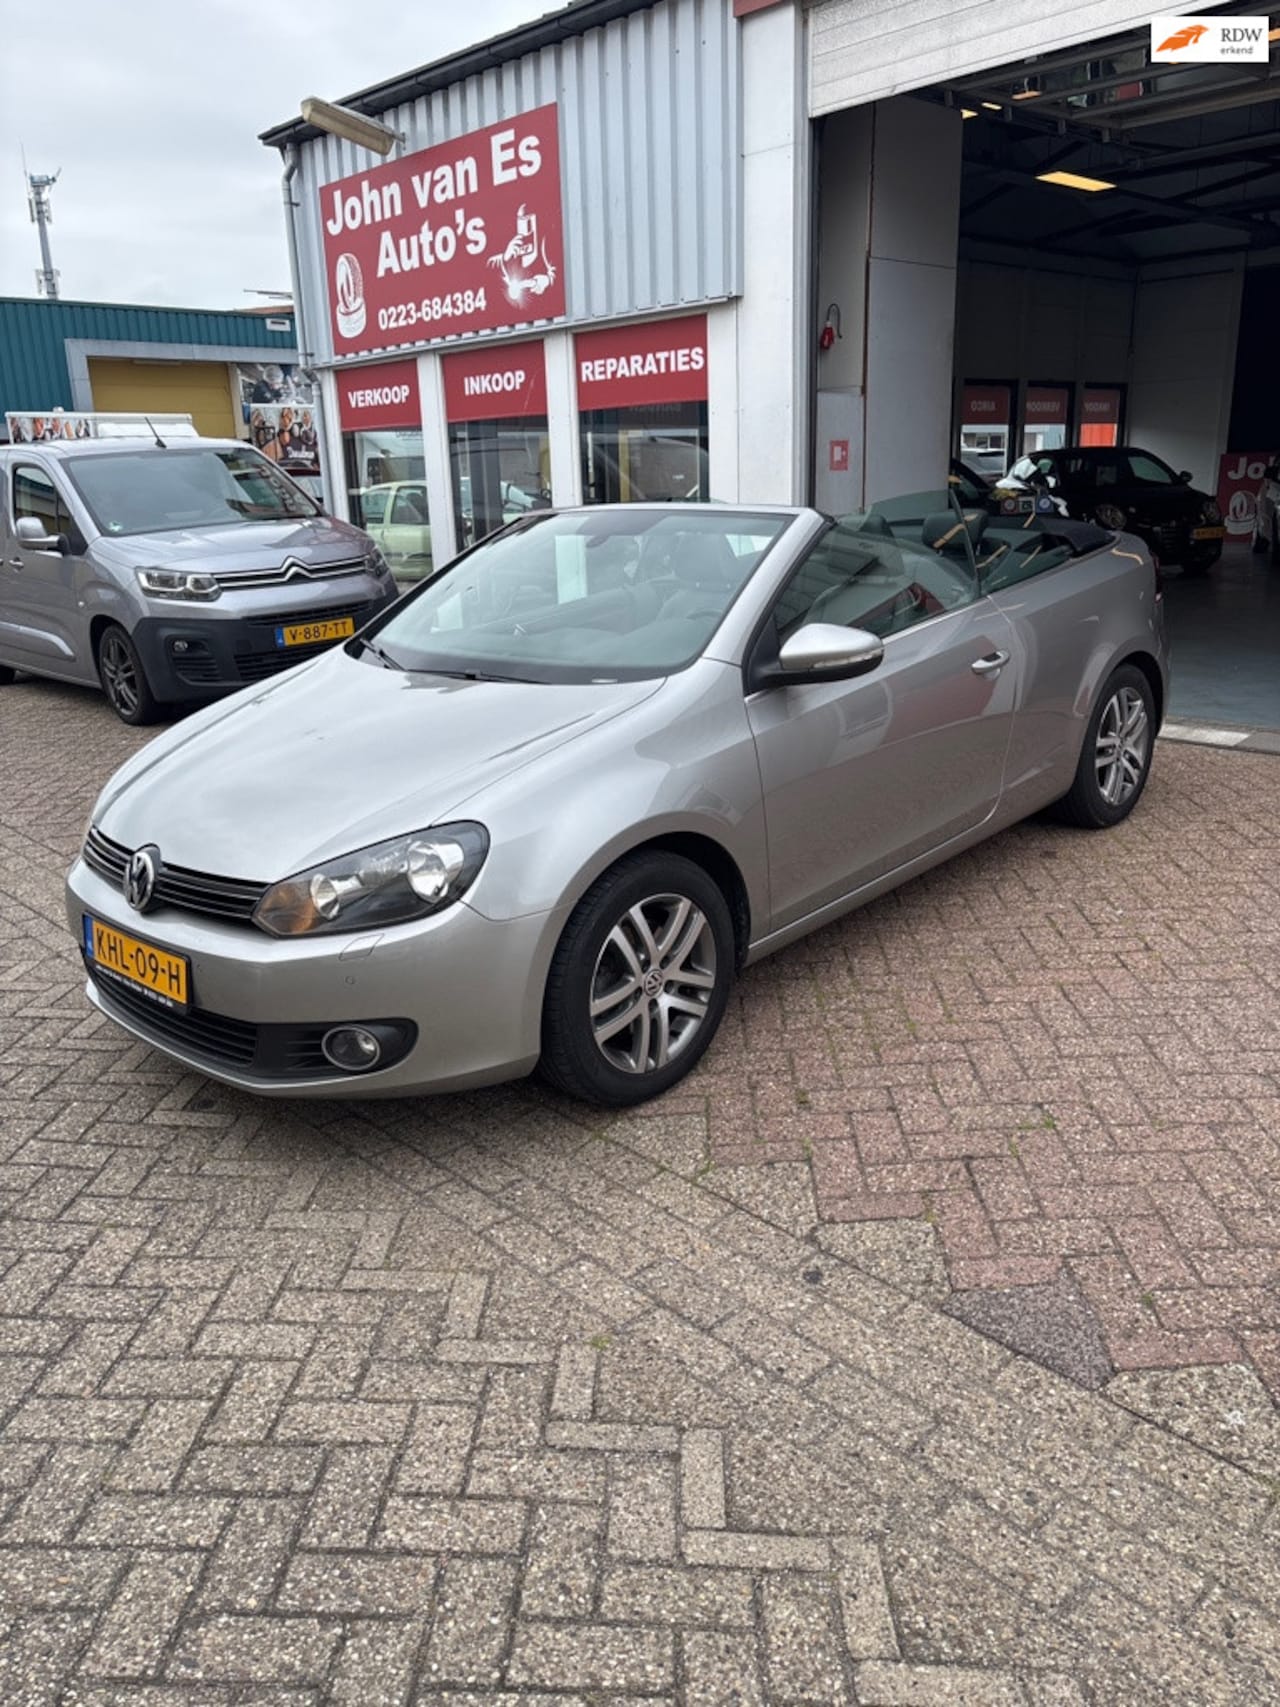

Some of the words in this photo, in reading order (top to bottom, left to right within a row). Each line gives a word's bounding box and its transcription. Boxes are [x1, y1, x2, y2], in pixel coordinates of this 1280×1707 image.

[326, 179, 403, 236] John
[411, 156, 479, 209] van
[490, 128, 542, 187] Es
[376, 208, 487, 278] Auto's
[378, 287, 487, 331] 0223-684384
[463, 369, 526, 396] INKOOP
[580, 346, 705, 383] REPARATIES
[347, 384, 411, 408] VERKOOP
[1227, 456, 1275, 480] Jo
[289, 620, 347, 641] V-887-TT
[96, 927, 181, 995] KHL-09-H
